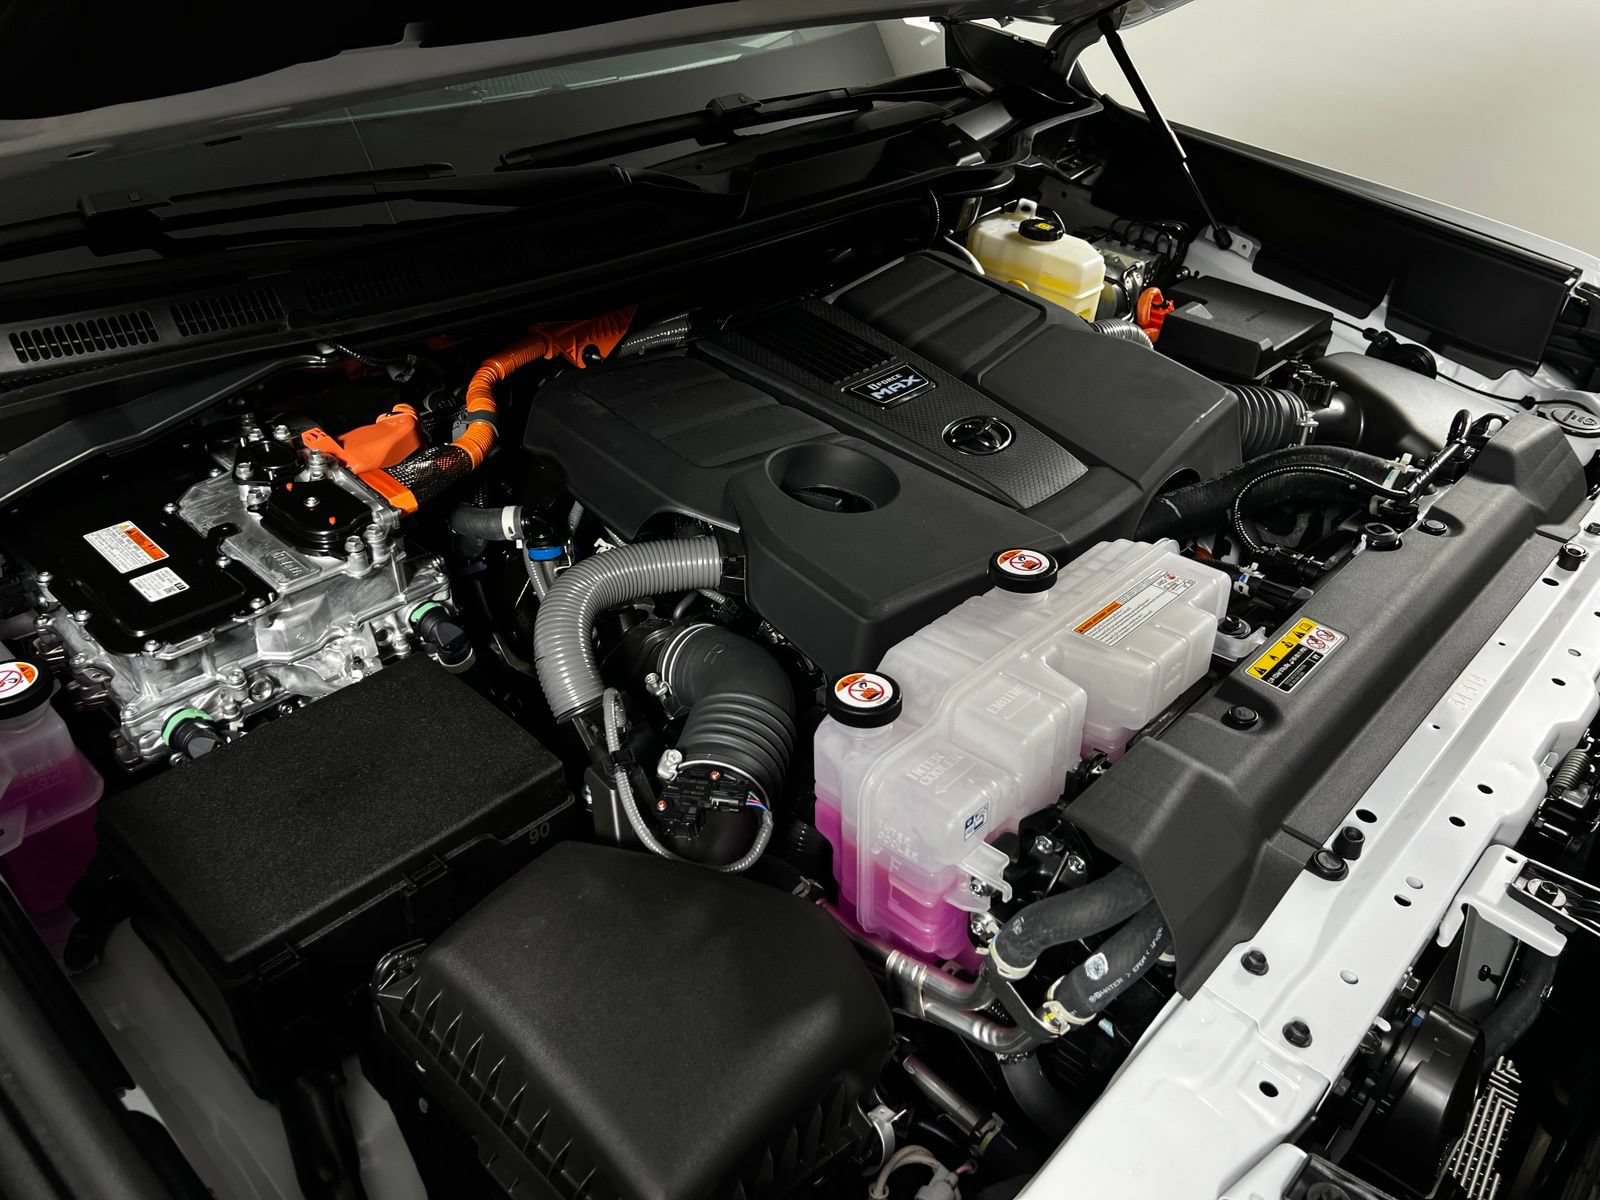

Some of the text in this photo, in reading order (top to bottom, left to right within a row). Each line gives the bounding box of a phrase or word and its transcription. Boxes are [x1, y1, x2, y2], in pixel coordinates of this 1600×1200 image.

[870, 374, 923, 400] MAX
[985, 682, 1026, 714] ENGINE
[906, 752, 945, 780] INTER
[919, 753, 964, 785] COOLER
[528, 821, 550, 845] 90
